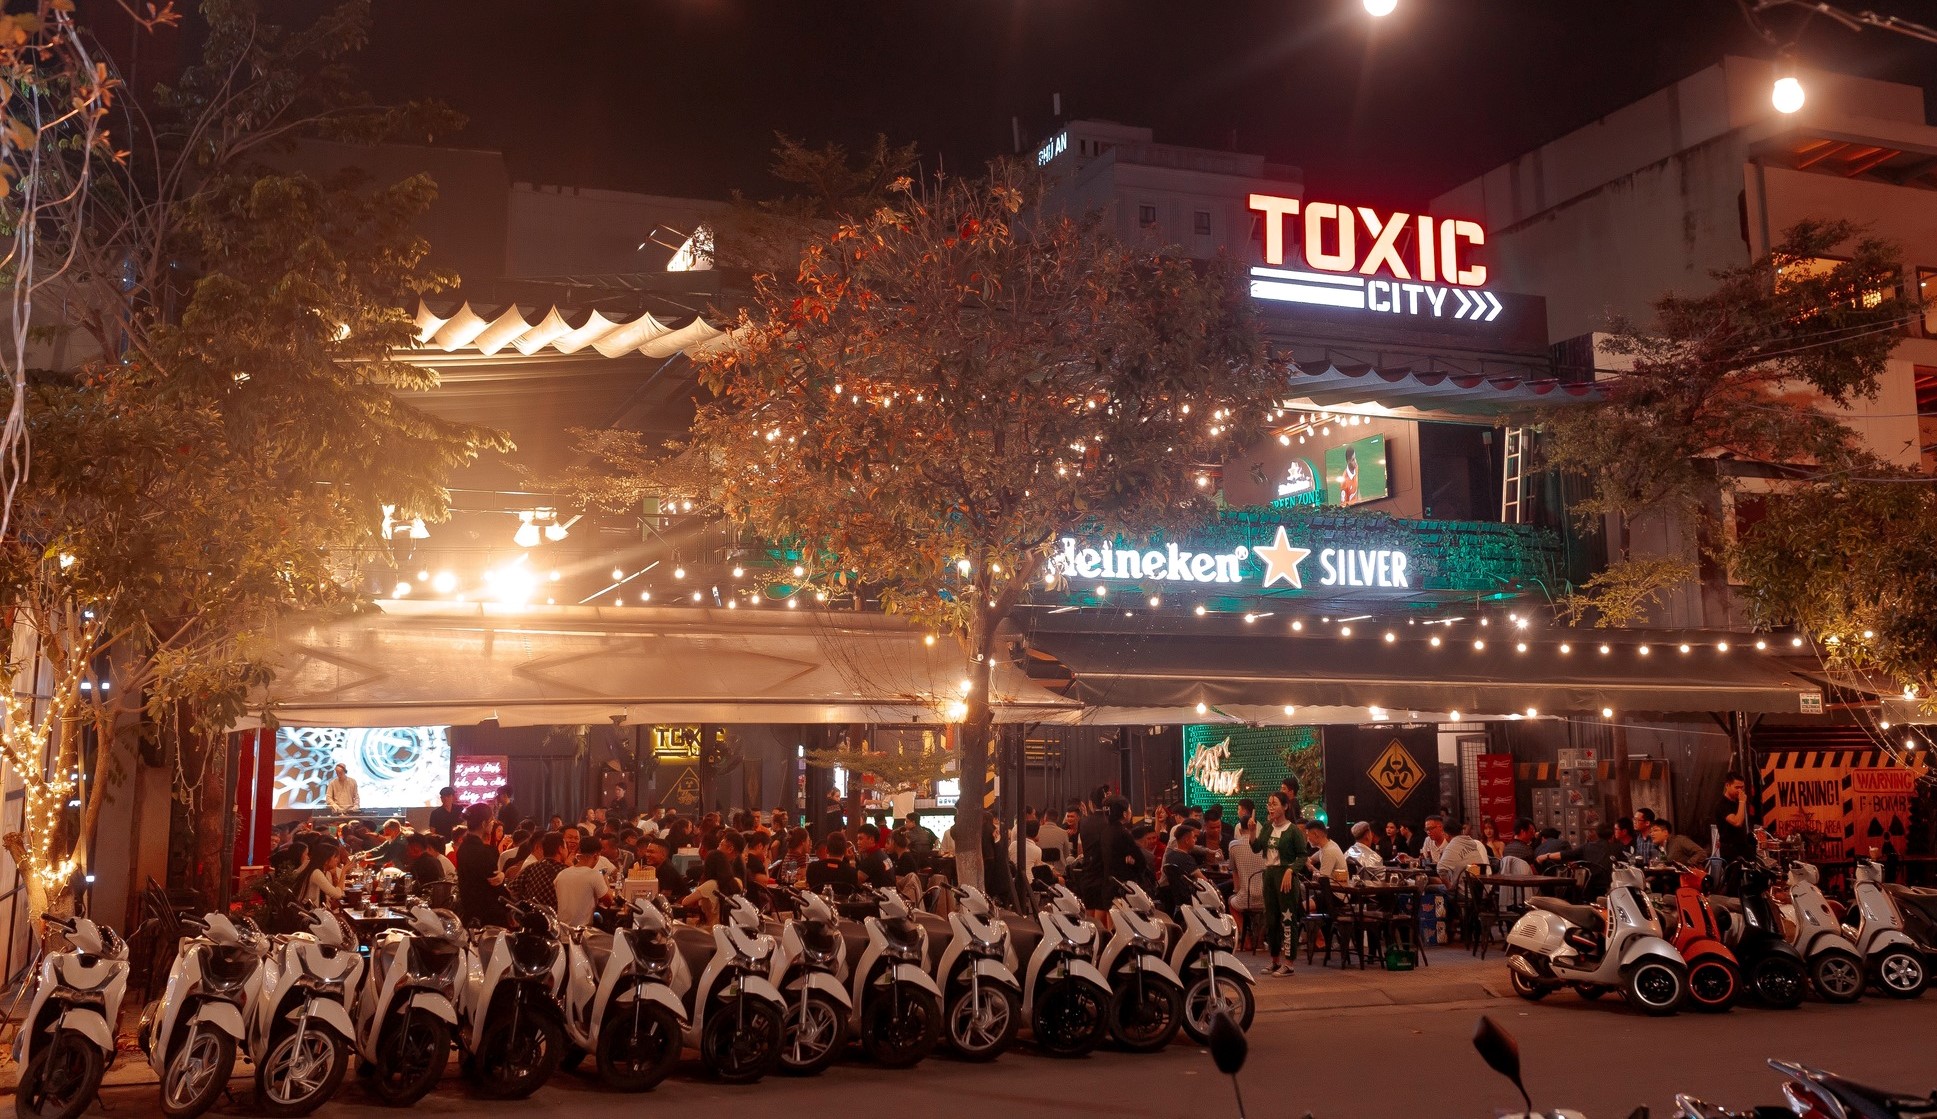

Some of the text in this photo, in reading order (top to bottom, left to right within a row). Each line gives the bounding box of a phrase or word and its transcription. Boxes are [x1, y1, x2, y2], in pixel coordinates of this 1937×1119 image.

[1055, 131, 1067, 157] AN
[1249, 193, 1487, 287] TOXIC
[1367, 280, 1448, 317] CITY
[1320, 548, 1409, 588] SILVER
[1777, 780, 1840, 807] WARNING!
[1856, 771, 1912, 790] WARNING
[1824, 819, 1842, 834] AREA
